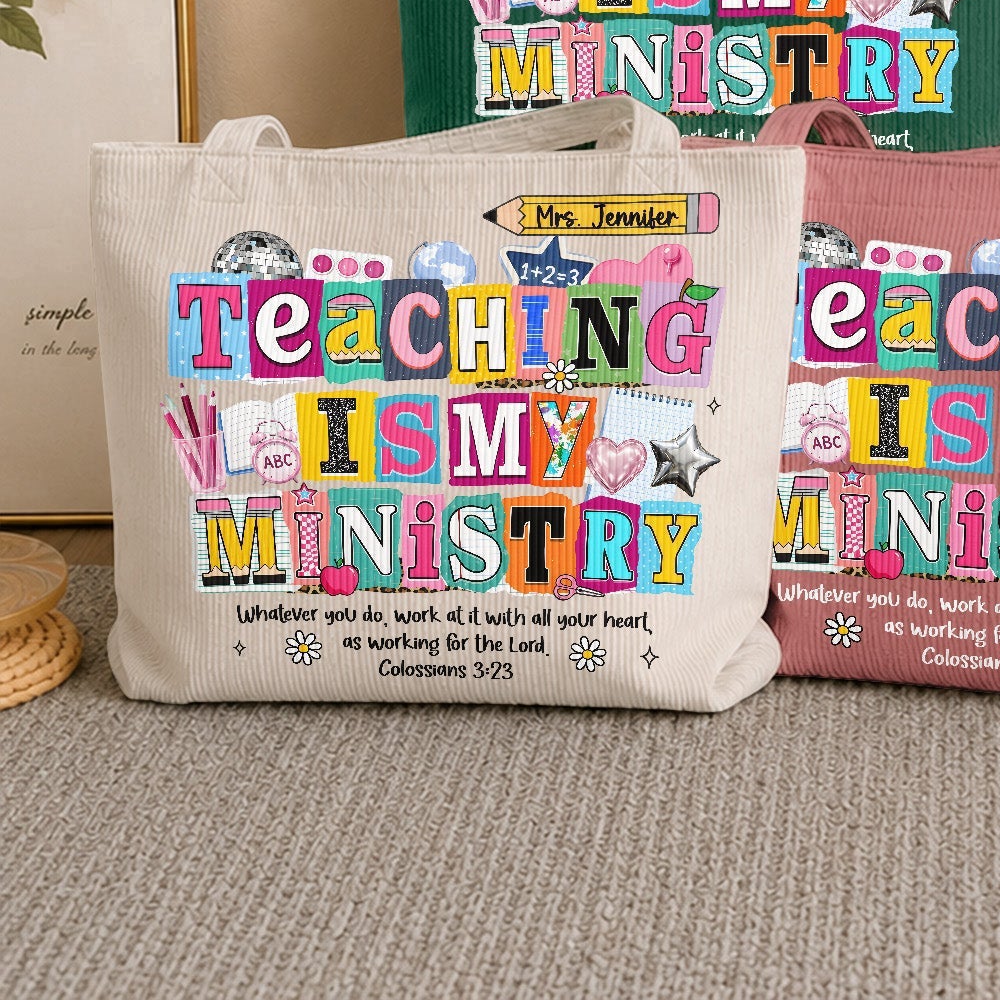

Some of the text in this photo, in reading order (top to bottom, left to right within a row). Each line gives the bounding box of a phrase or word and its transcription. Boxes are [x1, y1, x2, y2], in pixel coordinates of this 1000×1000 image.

[536, 204, 679, 229] Mrs. Jennifer
[520, 262, 580, 286] 1+2=3
[24, 297, 95, 331] simple
[21, 343, 36, 355] in
[41, 340, 62, 356] the
[870, 383, 990, 466] IS
[319, 396, 590, 480] IS MY
[812, 434, 842, 451] ABC
[263, 452, 293, 470] ABC
[776, 582, 861, 604] Whatever
[866, 592, 900, 609] you
[906, 591, 933, 614] do,
[939, 596, 988, 614] work
[236, 604, 653, 635] Whatever you do, work at it with all your heart,
[342, 632, 550, 657] as working for the Lord.
[884, 620, 904, 636] as
[910, 620, 987, 648] working
[378, 658, 514, 680] Colossians 3:23
